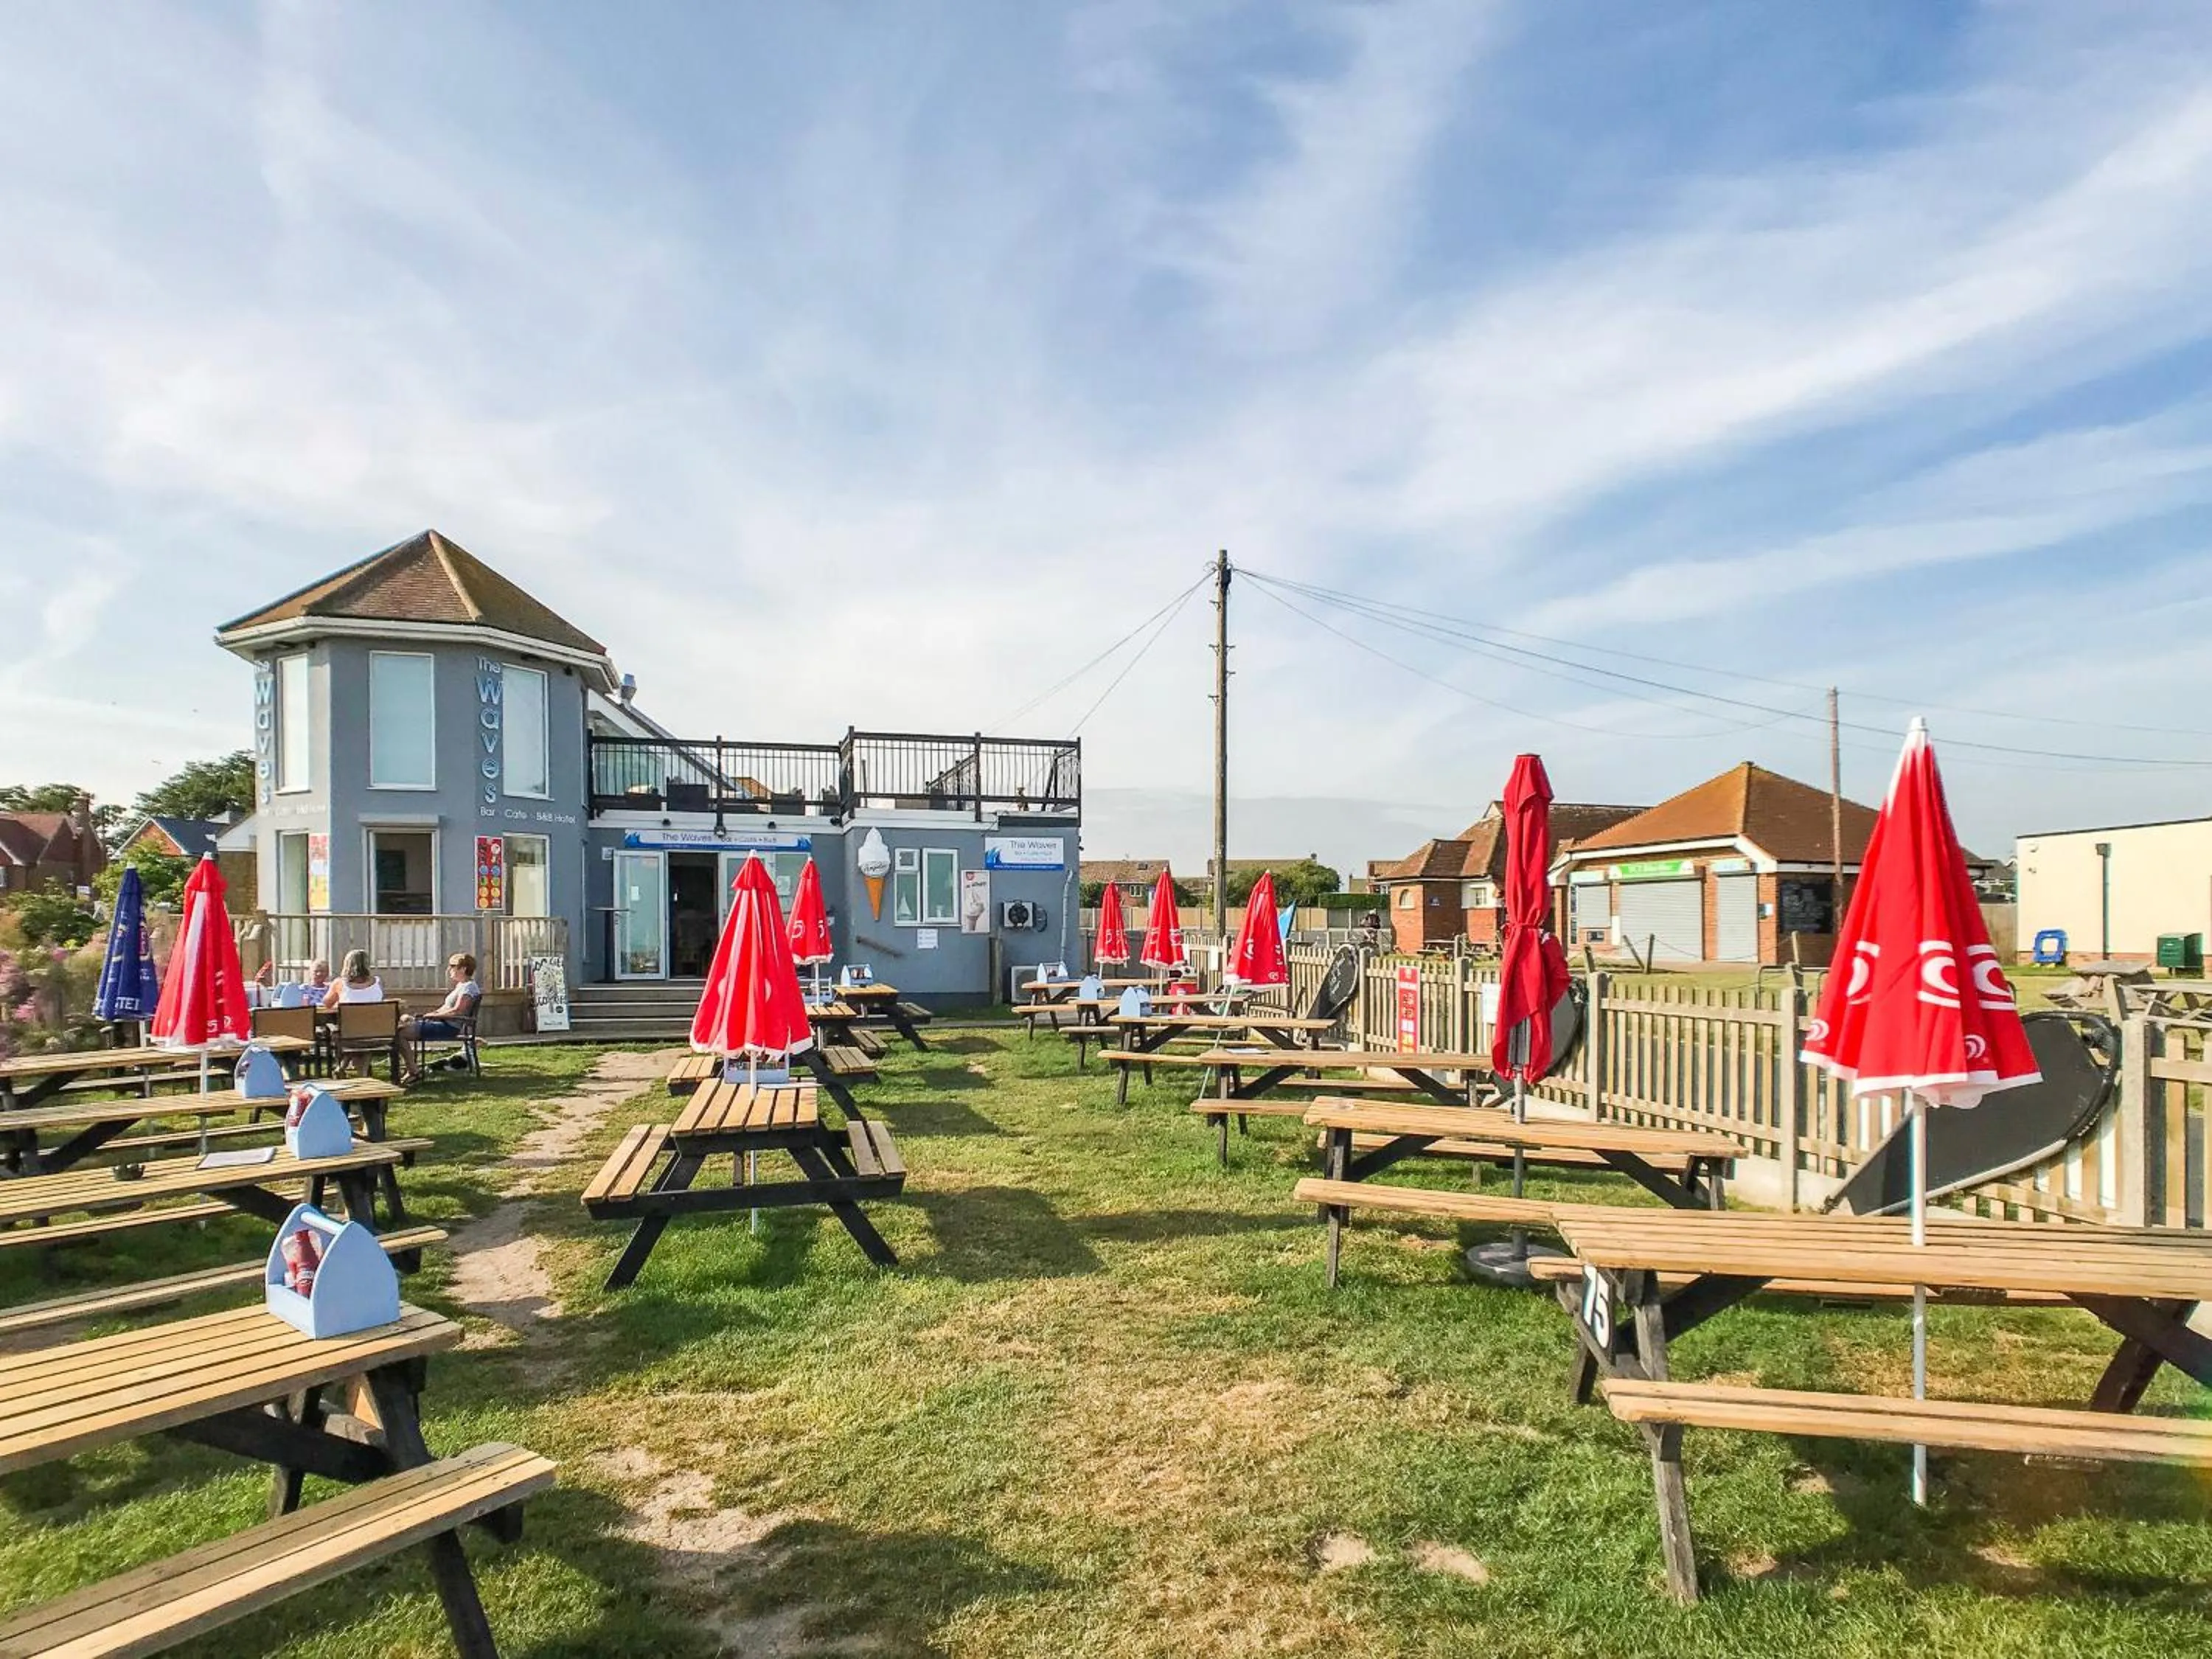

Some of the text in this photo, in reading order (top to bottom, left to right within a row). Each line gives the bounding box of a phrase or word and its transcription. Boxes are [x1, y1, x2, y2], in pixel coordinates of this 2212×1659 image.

[478, 656, 501, 674] The
[476, 676, 504, 804] Waves
[480, 806, 495, 816] Bar
[554, 813, 576, 824] Hotel
[663, 832, 679, 841] The
[681, 833, 712, 841] Waves
[1011, 841, 1057, 849] The Waves
